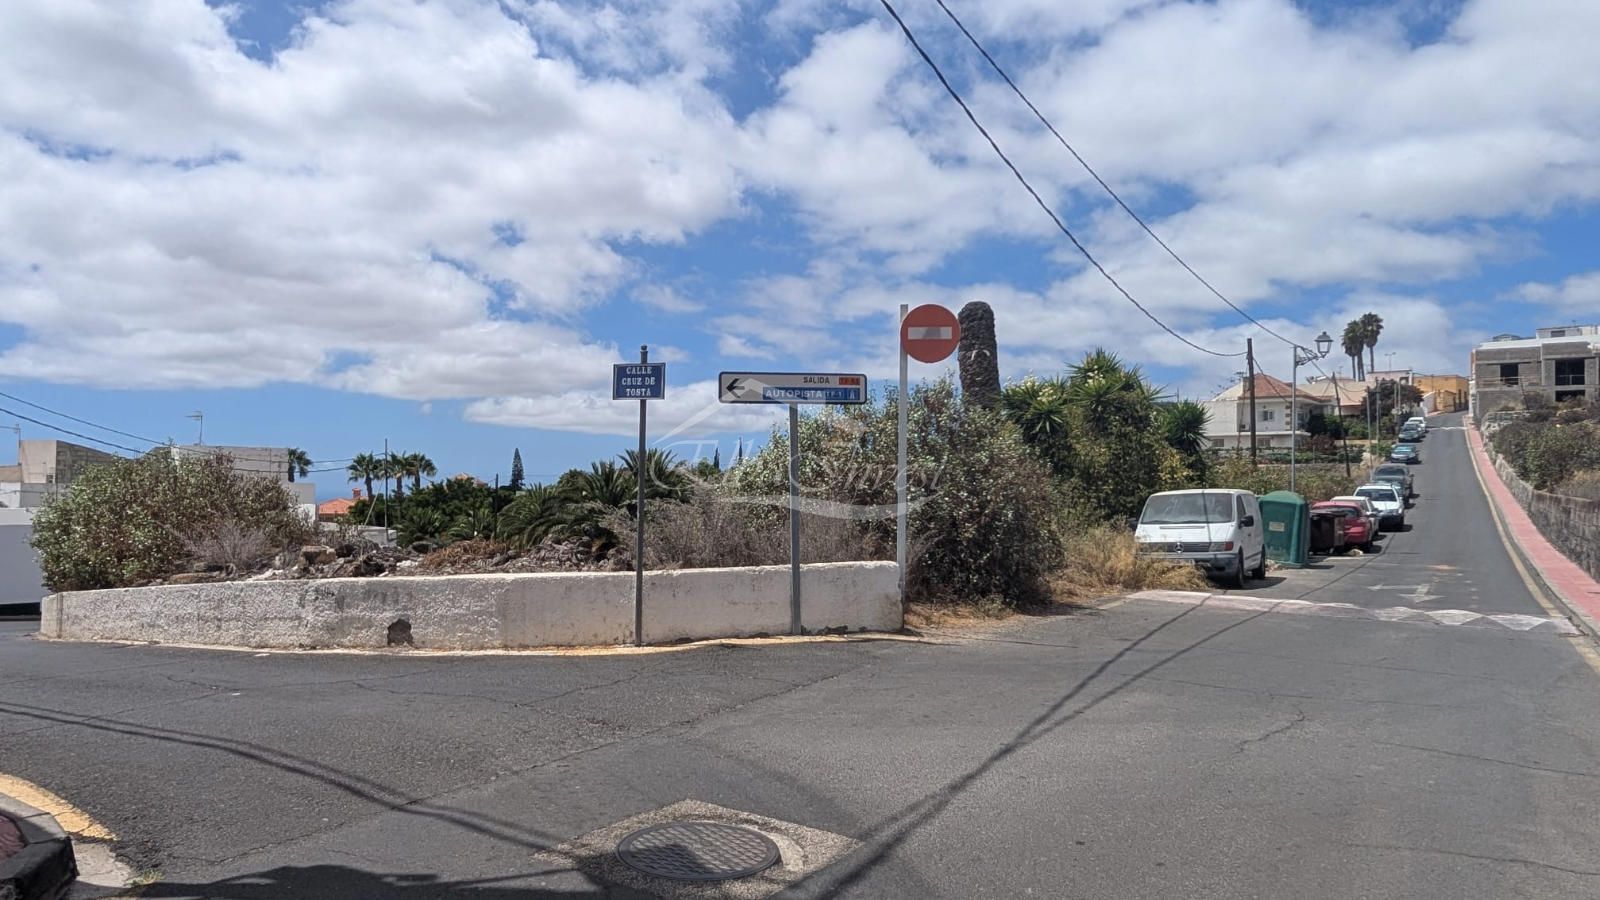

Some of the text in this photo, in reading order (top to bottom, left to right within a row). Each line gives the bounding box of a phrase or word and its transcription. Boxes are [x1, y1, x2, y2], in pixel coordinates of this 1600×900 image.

[626, 366, 652, 374] CALLE
[644, 377, 656, 385] DE
[803, 376, 830, 384] SALIDA
[626, 388, 651, 396] TOSTA
[765, 389, 823, 398] AUTOPISTA
